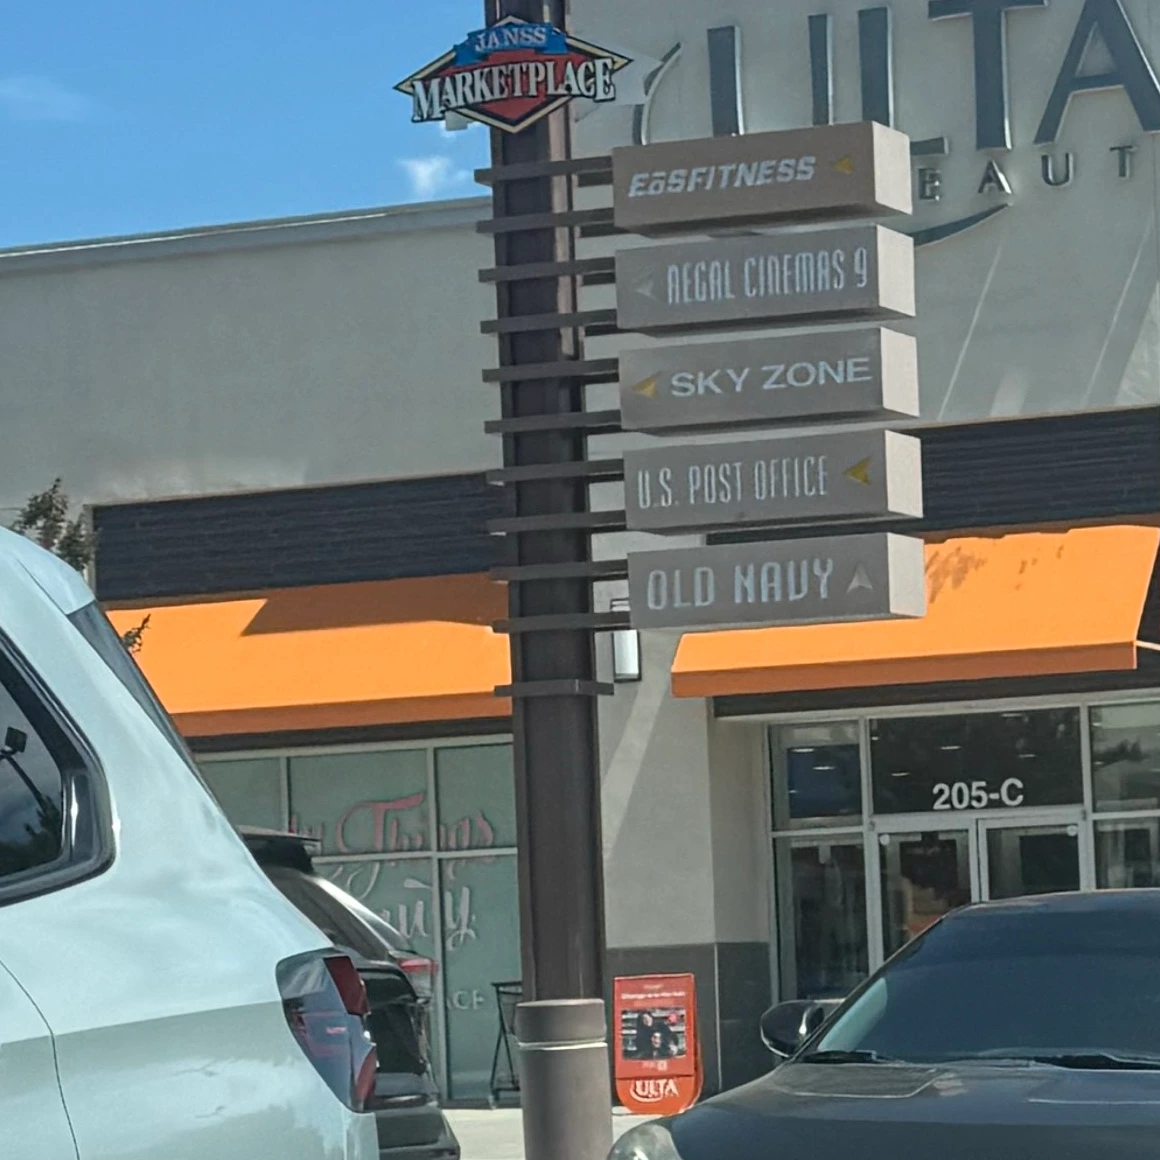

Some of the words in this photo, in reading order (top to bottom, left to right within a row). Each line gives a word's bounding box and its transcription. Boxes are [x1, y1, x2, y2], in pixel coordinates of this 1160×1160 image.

[474, 26, 547, 51] JANSS
[412, 57, 616, 122] MARKETPLACE
[667, 260, 736, 305] REGAL
[743, 248, 845, 298] CINEMAS
[854, 246, 868, 288] 9
[670, 366, 751, 397] SKY
[761, 356, 874, 391] ZONE
[637, 466, 679, 509] U.S.
[688, 461, 744, 505] POST
[753, 455, 828, 500] OFFICE
[646, 565, 715, 610] OLD
[733, 556, 834, 604] NAVY
[932, 777, 1025, 811] 205-C
[634, 1078, 680, 1097] ULTA
